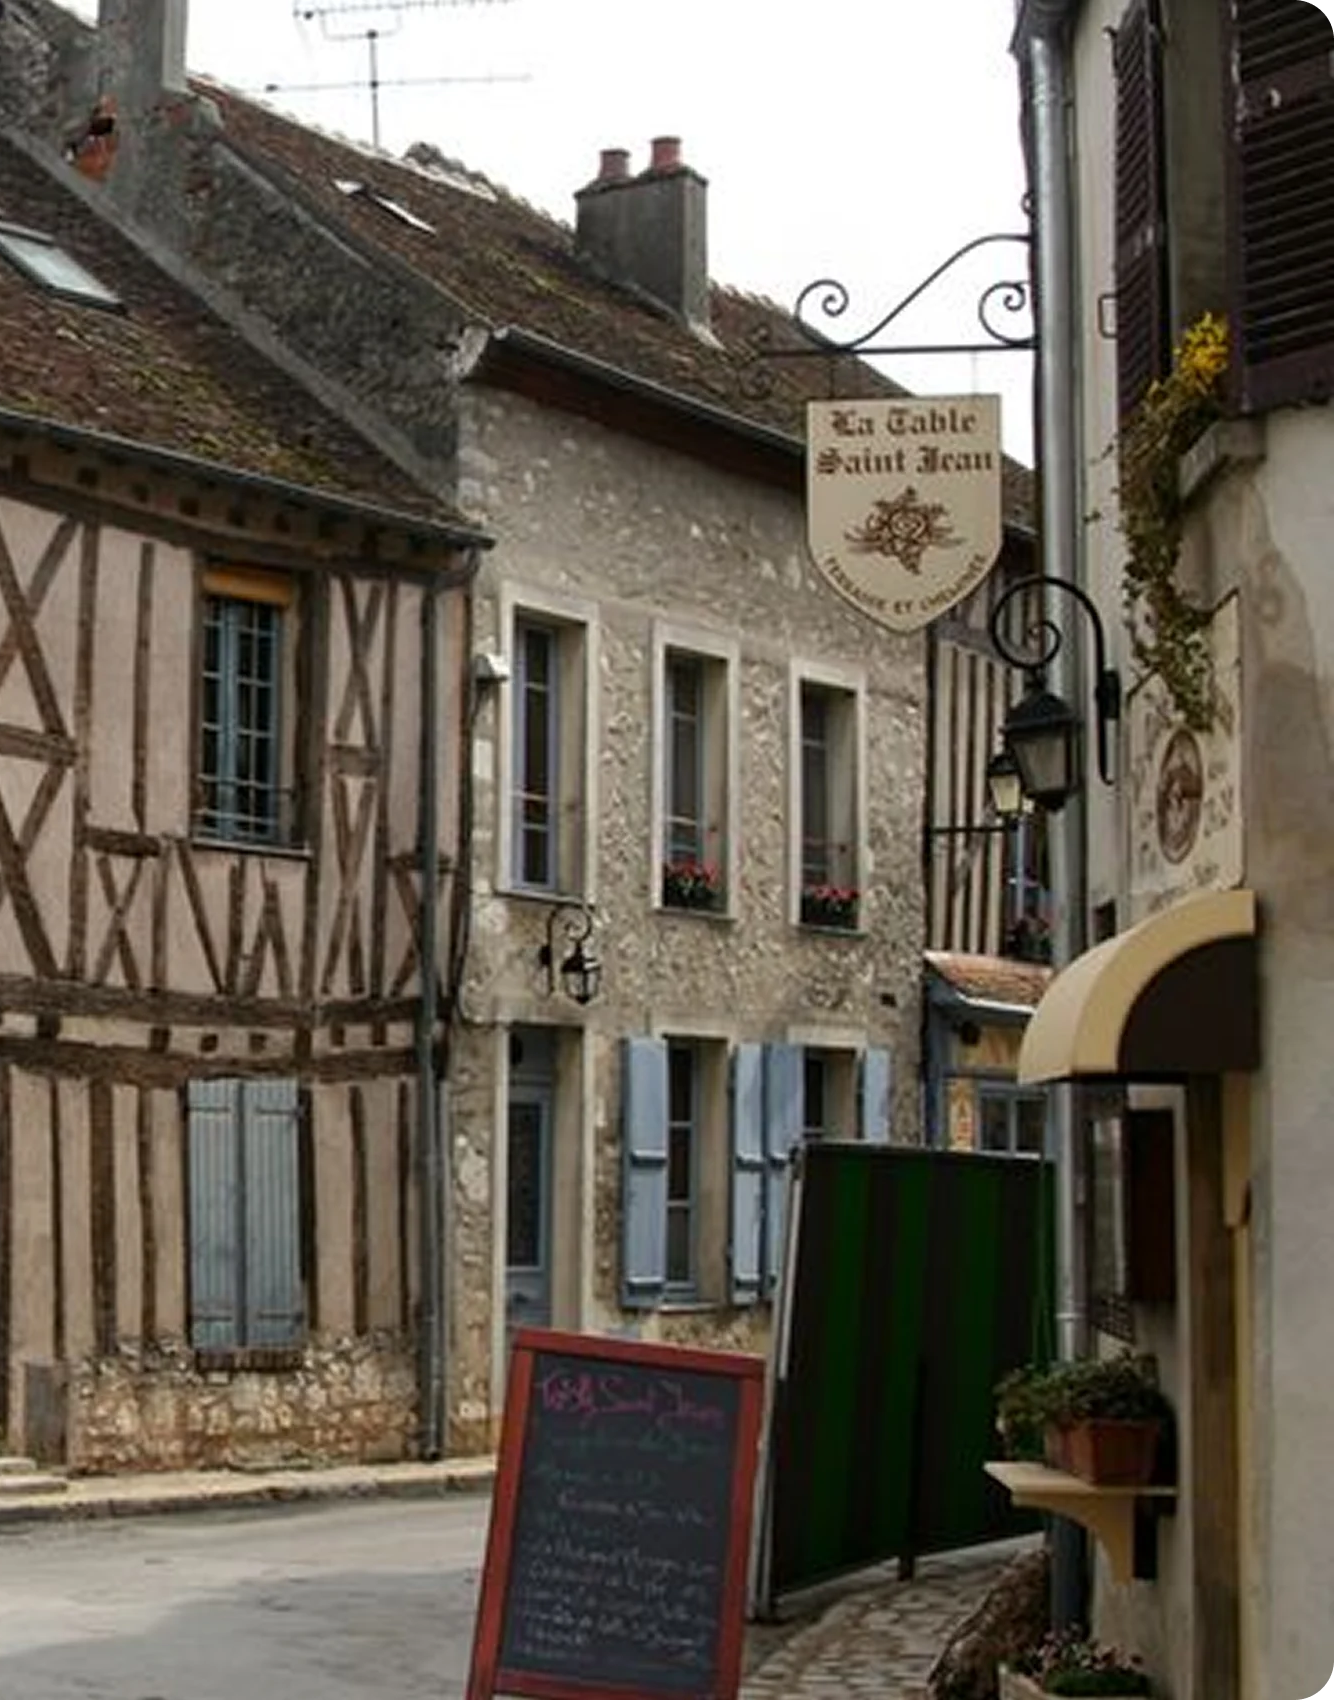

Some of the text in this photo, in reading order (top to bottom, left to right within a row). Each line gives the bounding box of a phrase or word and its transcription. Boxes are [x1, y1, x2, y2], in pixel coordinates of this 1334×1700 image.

[831, 405, 977, 436] La Table
[817, 445, 994, 475] Saint Jean
